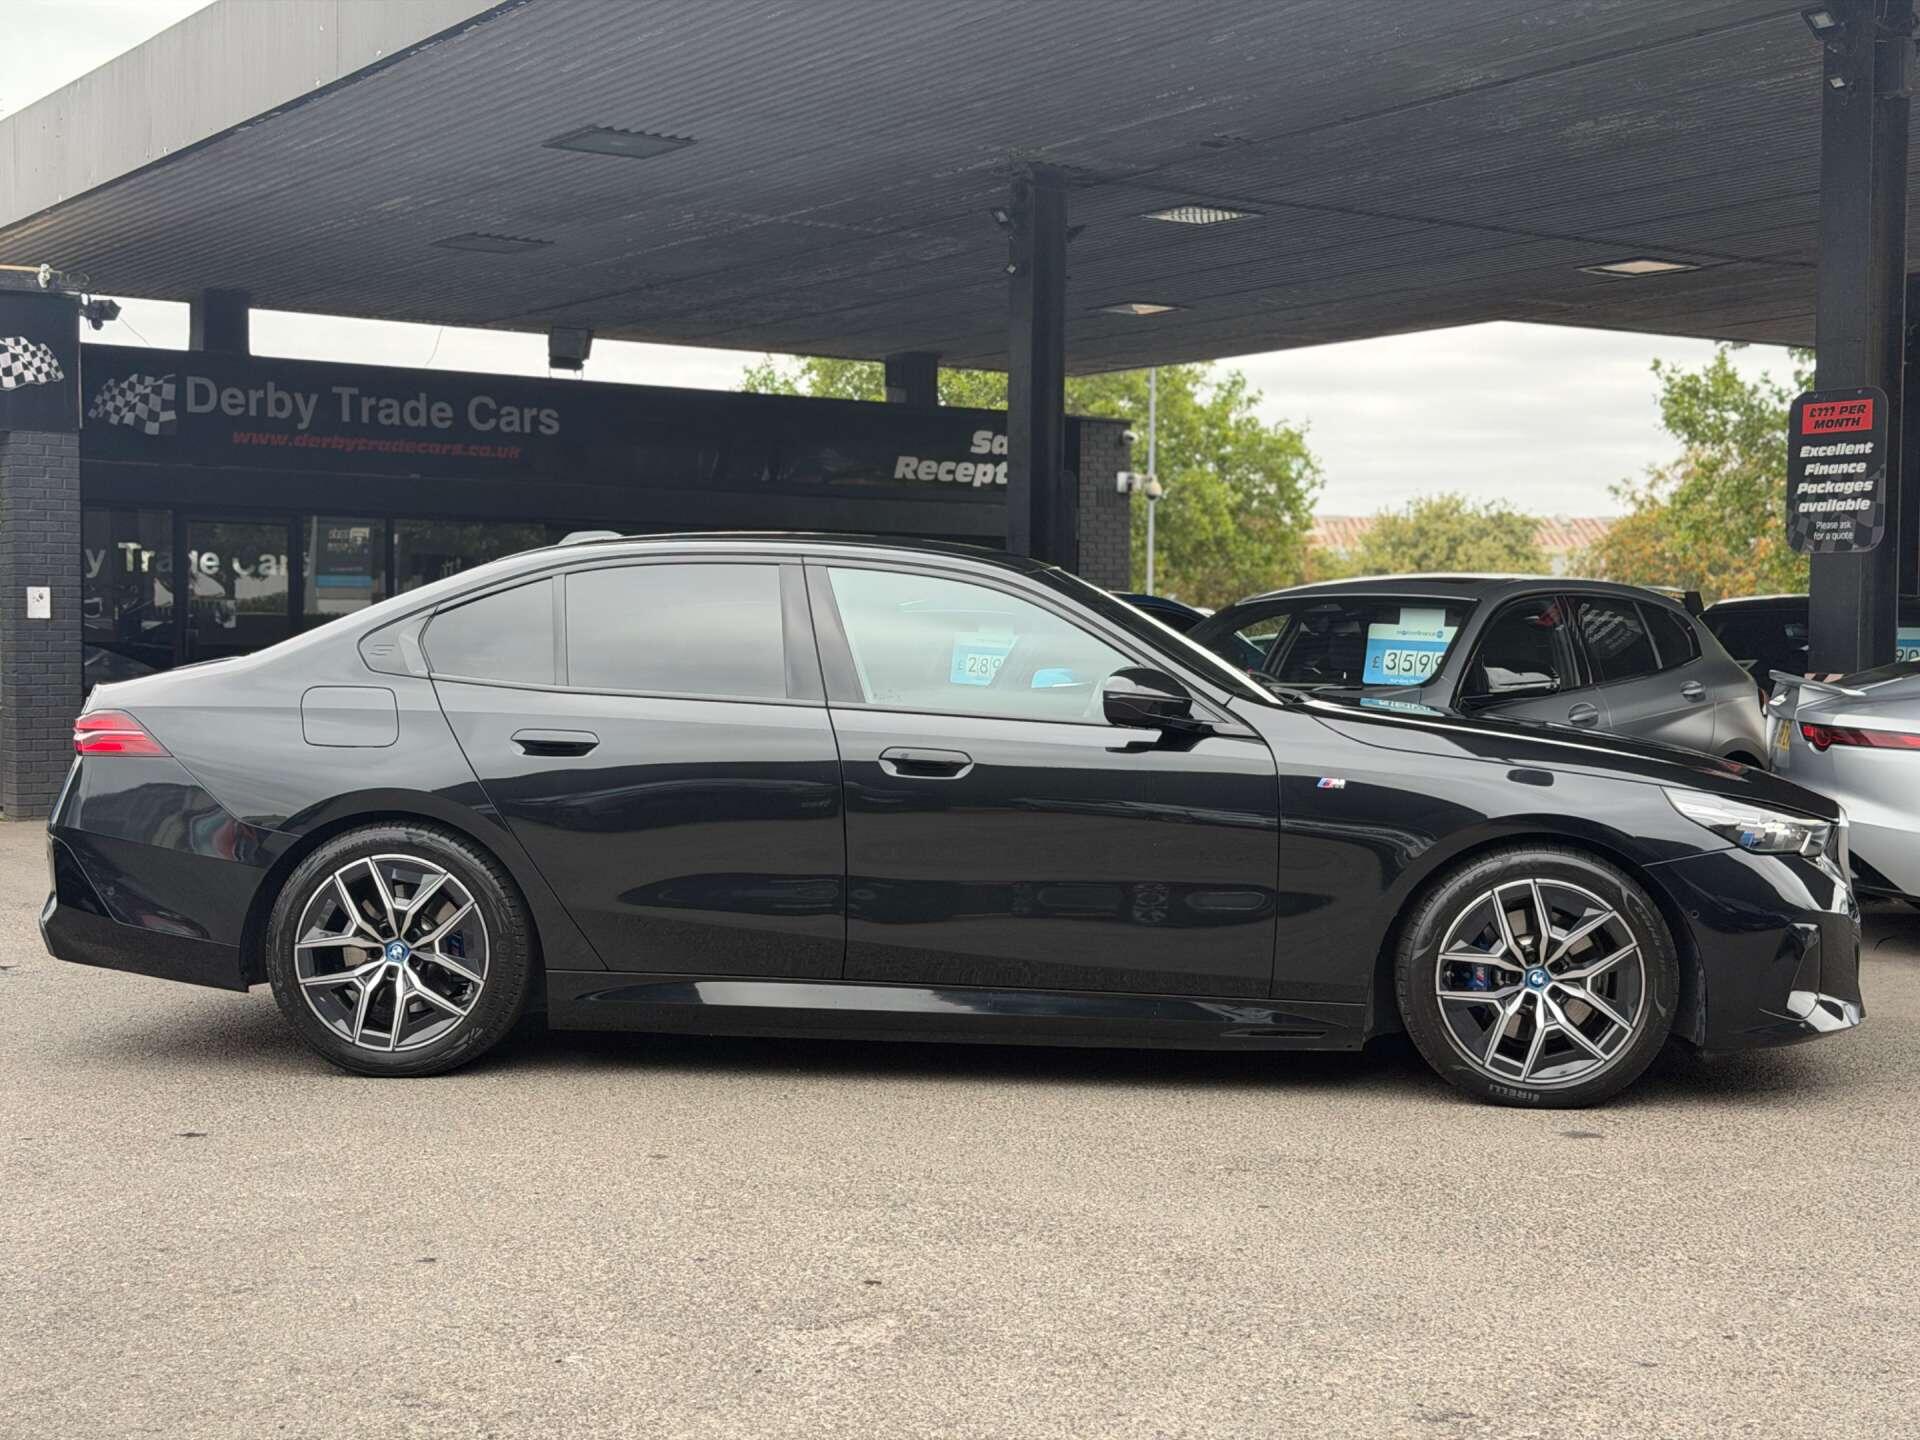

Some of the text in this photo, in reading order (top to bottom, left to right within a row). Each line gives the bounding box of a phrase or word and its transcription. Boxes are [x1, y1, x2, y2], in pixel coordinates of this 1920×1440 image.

[186, 376, 560, 435] Derby Trade Cars
[1839, 404, 1866, 415] PER
[1814, 417, 1861, 430] MONTH
[1800, 442, 1873, 457] Excellent
[1804, 461, 1867, 476] Finance
[1797, 480, 1874, 495] Packages
[1798, 498, 1871, 513] available
